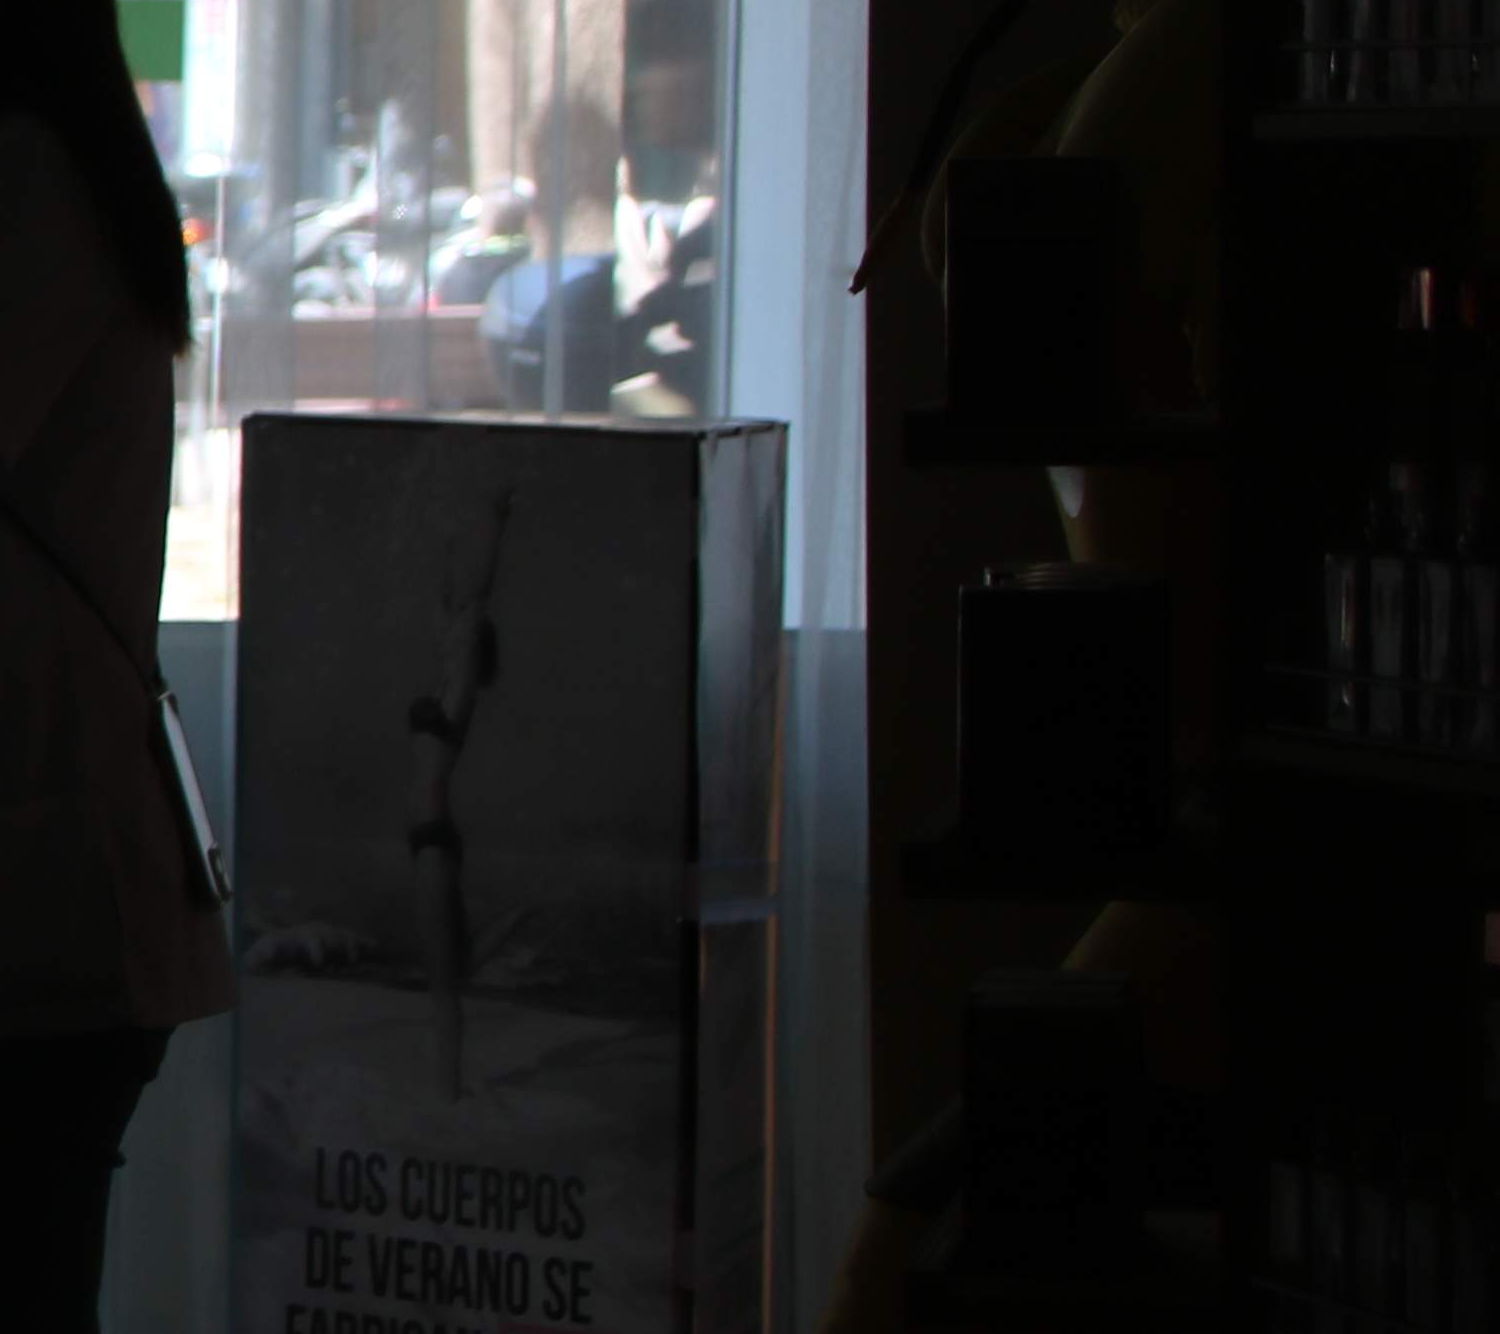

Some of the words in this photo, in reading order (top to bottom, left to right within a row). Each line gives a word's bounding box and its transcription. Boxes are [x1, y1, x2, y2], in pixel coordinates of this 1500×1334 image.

[316, 1147, 388, 1216] LOS
[400, 1156, 587, 1240] CUERPOS
[304, 1226, 356, 1292] DE
[367, 1233, 530, 1316] VERANO
[542, 1256, 594, 1324] SE
